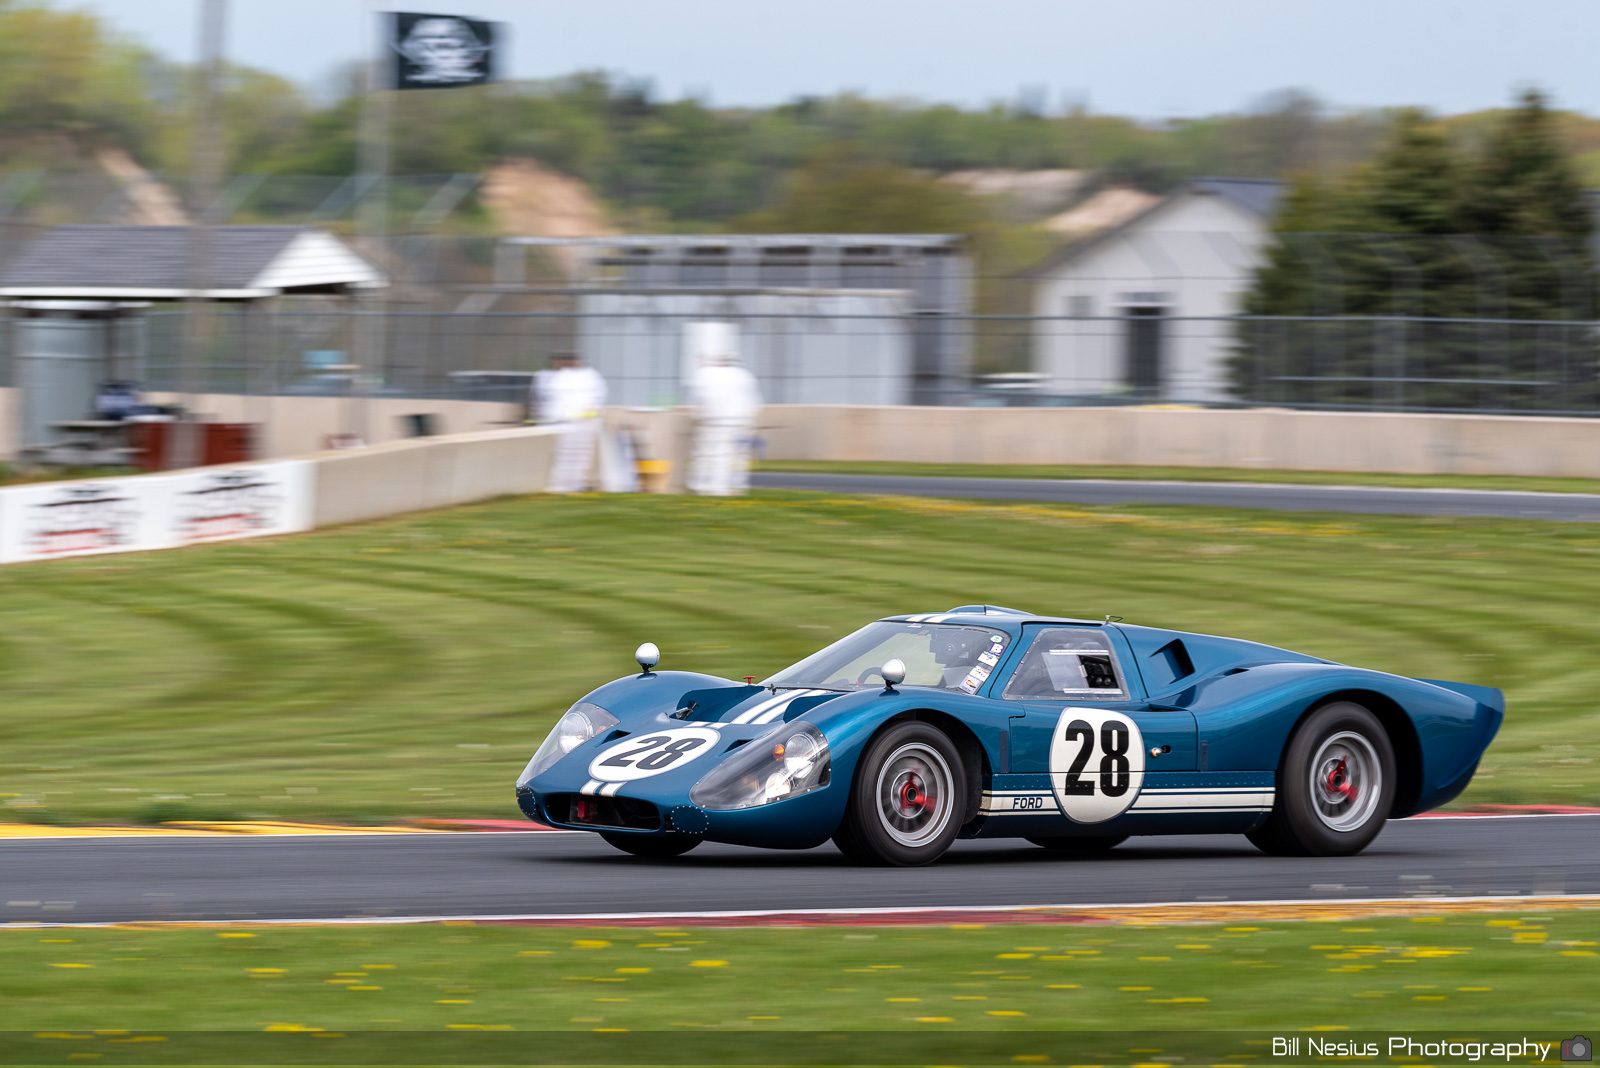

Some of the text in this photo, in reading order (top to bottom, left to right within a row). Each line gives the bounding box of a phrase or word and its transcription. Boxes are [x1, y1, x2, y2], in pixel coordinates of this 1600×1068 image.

[598, 735, 707, 770] 28
[1065, 719, 1130, 797] 28
[1013, 796, 1043, 809] FORD
